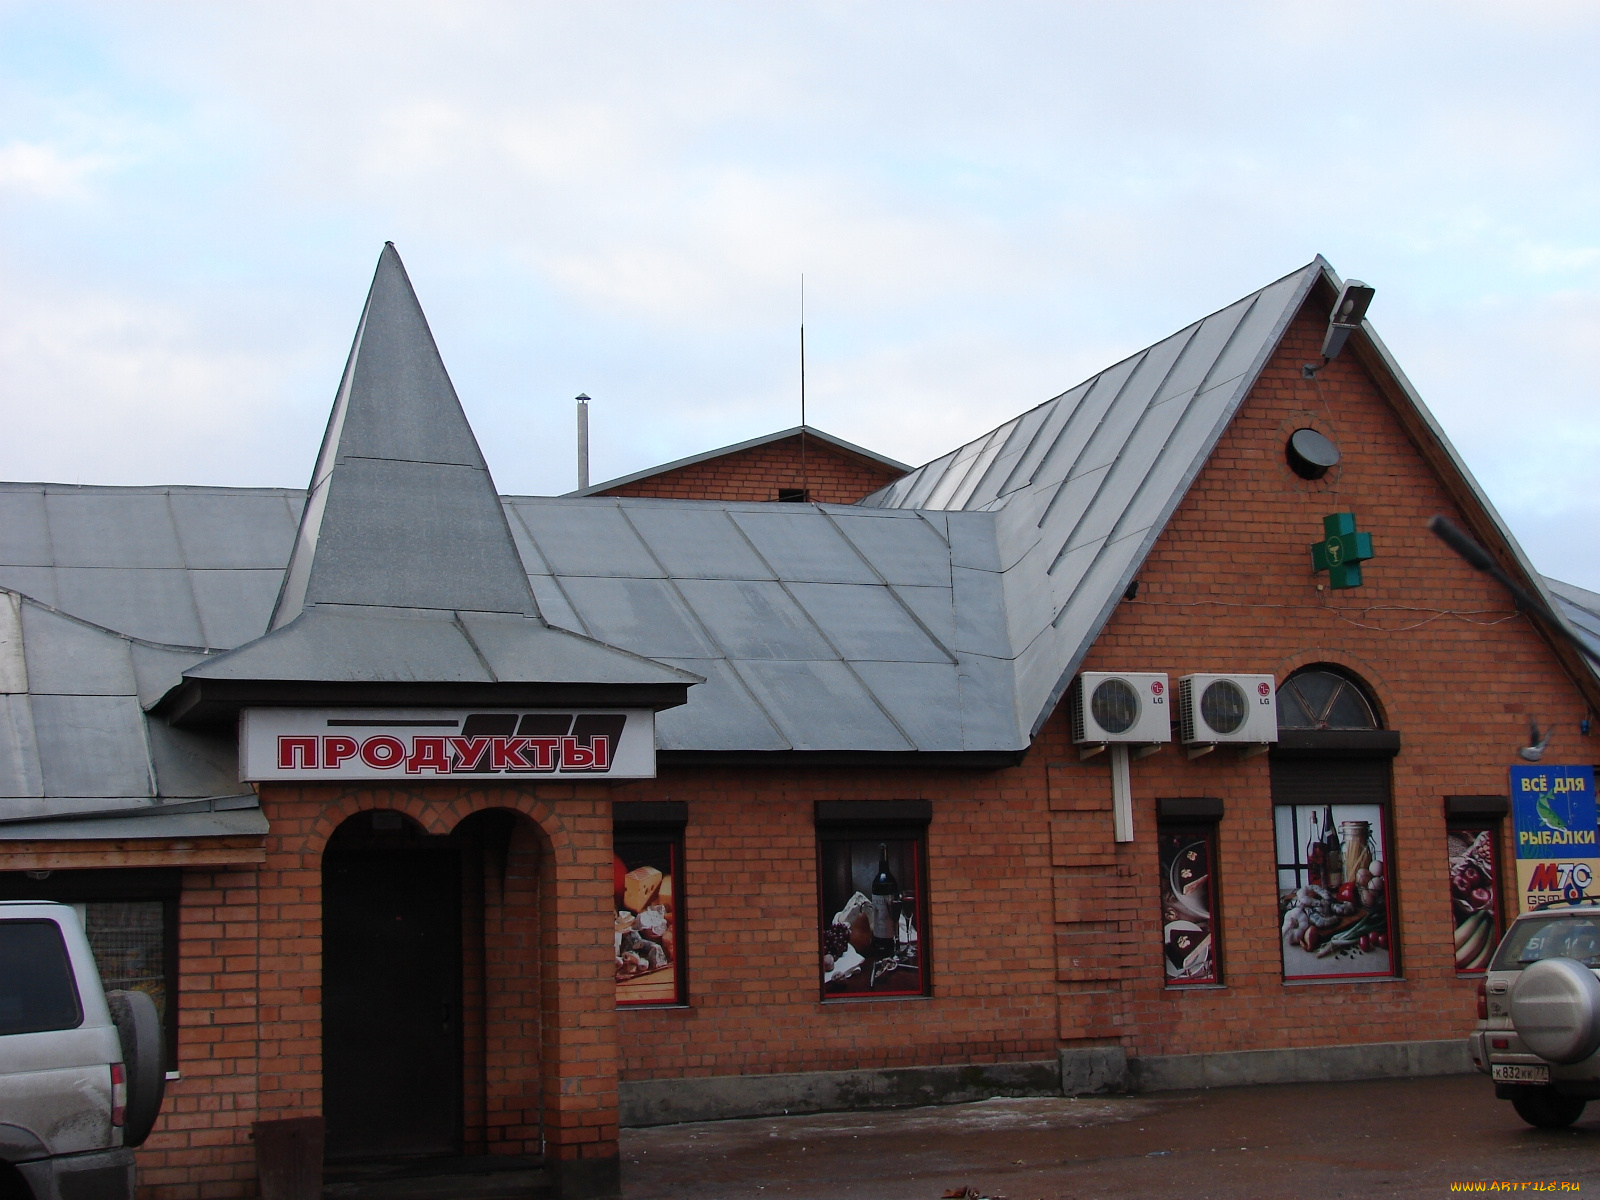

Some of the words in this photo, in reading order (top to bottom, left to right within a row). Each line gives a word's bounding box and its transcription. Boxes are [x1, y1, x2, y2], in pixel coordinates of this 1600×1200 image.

[277, 735, 610, 774] ПРОДУКТЫ
[1521, 775, 1548, 792] ВСЁ
[1554, 777, 1585, 793] ДЛЯ
[1520, 831, 1596, 845] РЫБАЛКИ
